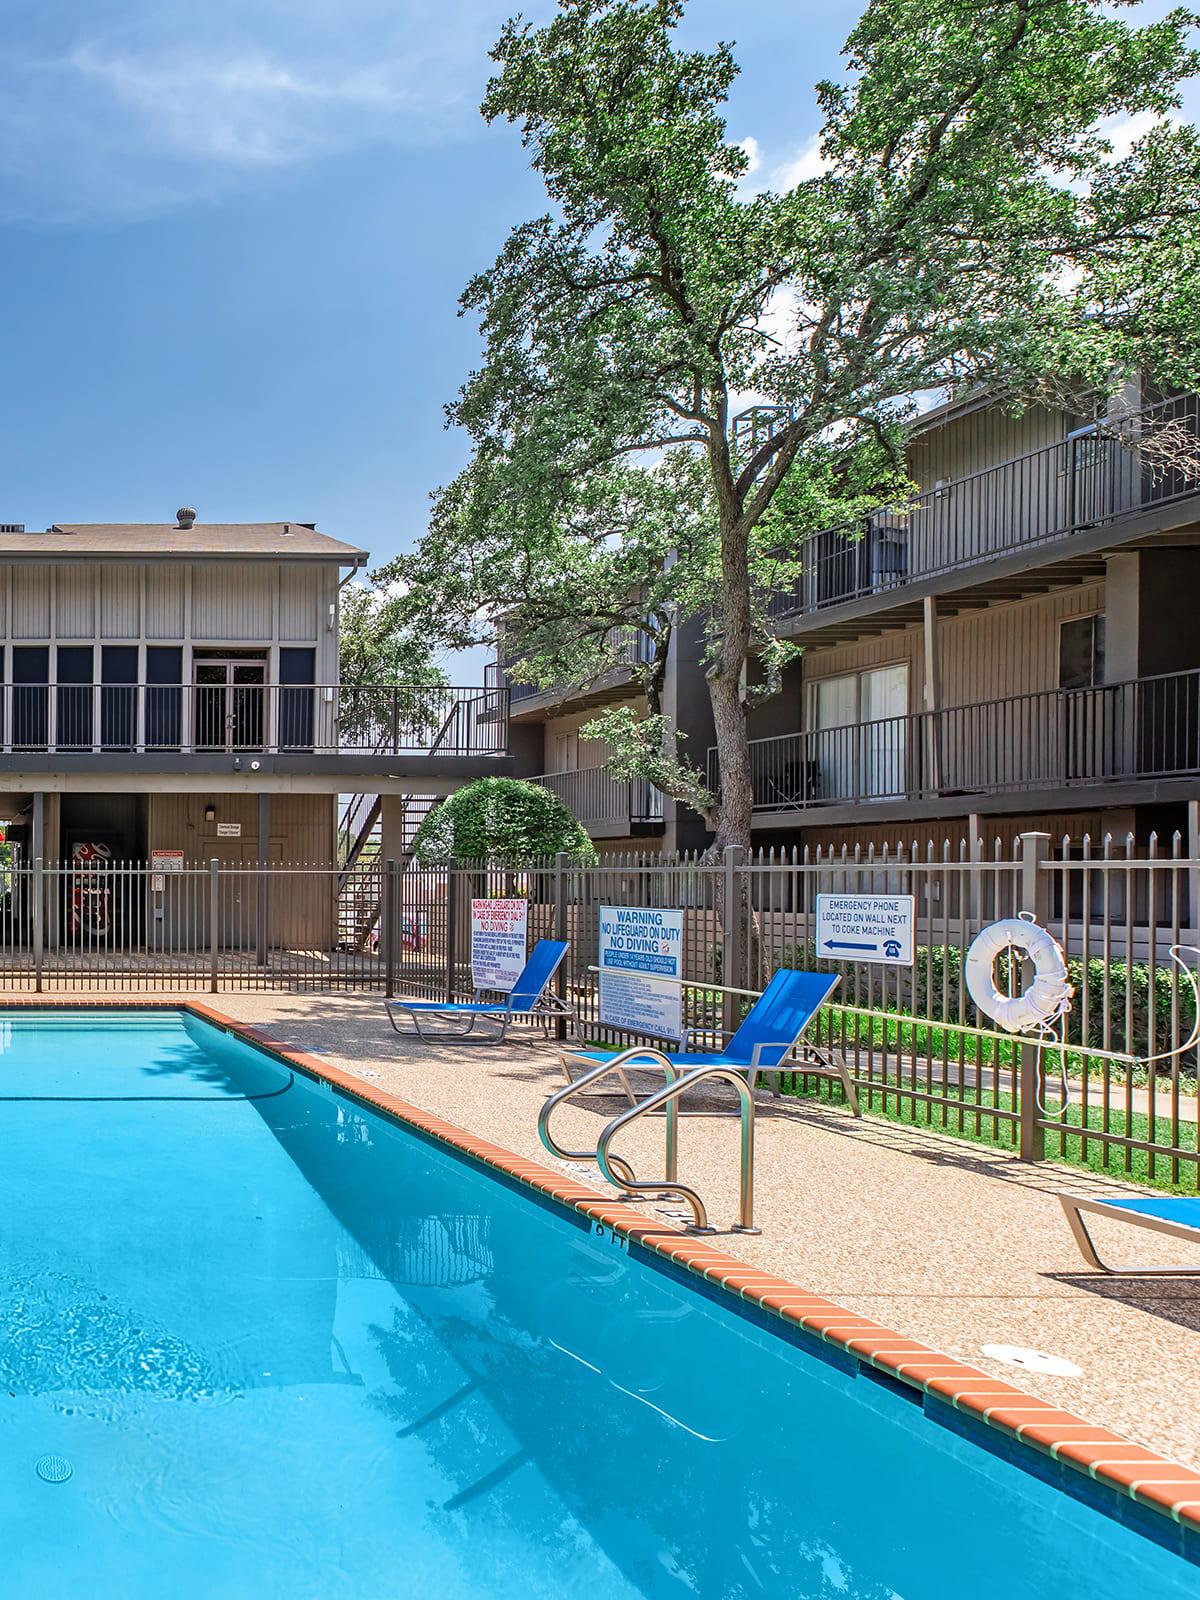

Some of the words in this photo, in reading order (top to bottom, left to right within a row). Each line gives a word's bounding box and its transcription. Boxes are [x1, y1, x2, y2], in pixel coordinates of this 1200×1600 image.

[830, 900, 872, 910] EMERGENCY
[874, 902, 899, 911] PHONE
[616, 911, 662, 926] WARNING
[822, 912, 852, 922] LOCATED
[854, 914, 864, 922] ON
[865, 914, 885, 923] WALL
[887, 915, 907, 924] NEXT
[480, 921, 488, 930] NO
[490, 922, 508, 932] DIVING
[602, 922, 611, 934] NO
[612, 924, 648, 938] LIFEGUARD
[650, 926, 660, 938] ON
[661, 928, 680, 940] DUTY
[832, 924, 840, 933] TO
[842, 925, 860, 934] COKE
[862, 926, 896, 936] MACHINE
[610, 936, 624, 948] NO
[626, 938, 658, 952] DIVING
[609, 1015, 620, 1023] CASE
[620, 1016, 626, 1024] OF
[627, 1018, 653, 1030] EMERGENCY
[654, 1024, 666, 1033] CALL
[611, 1232, 626, 1248] FT
